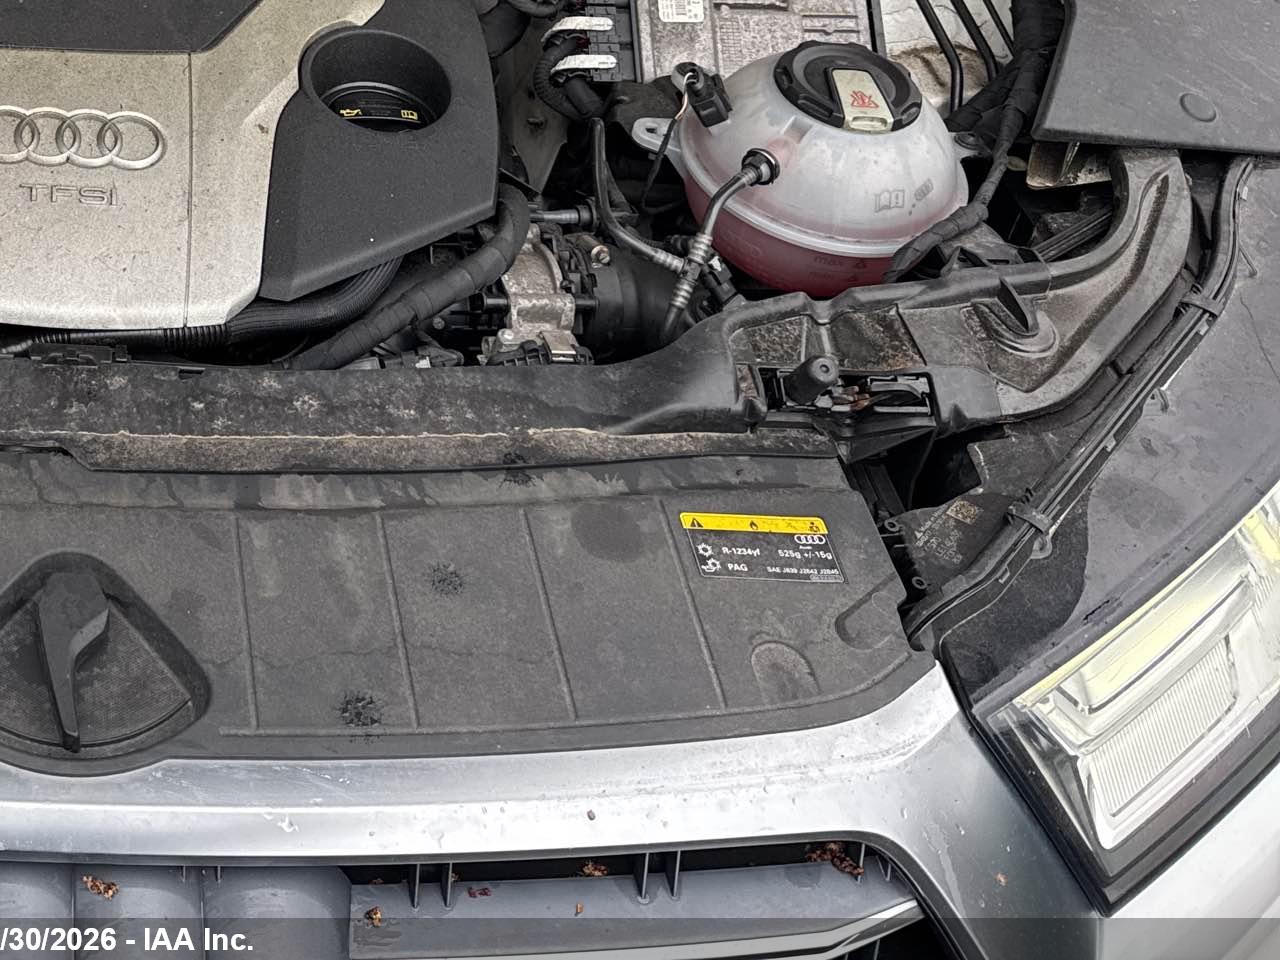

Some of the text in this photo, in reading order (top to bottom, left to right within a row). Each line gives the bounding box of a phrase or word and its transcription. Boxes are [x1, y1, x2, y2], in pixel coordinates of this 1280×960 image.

[18, 182, 119, 207] TFSI
[721, 547, 761, 557] R-1234yf
[777, 549, 801, 559] 525g
[727, 563, 748, 572] PAG
